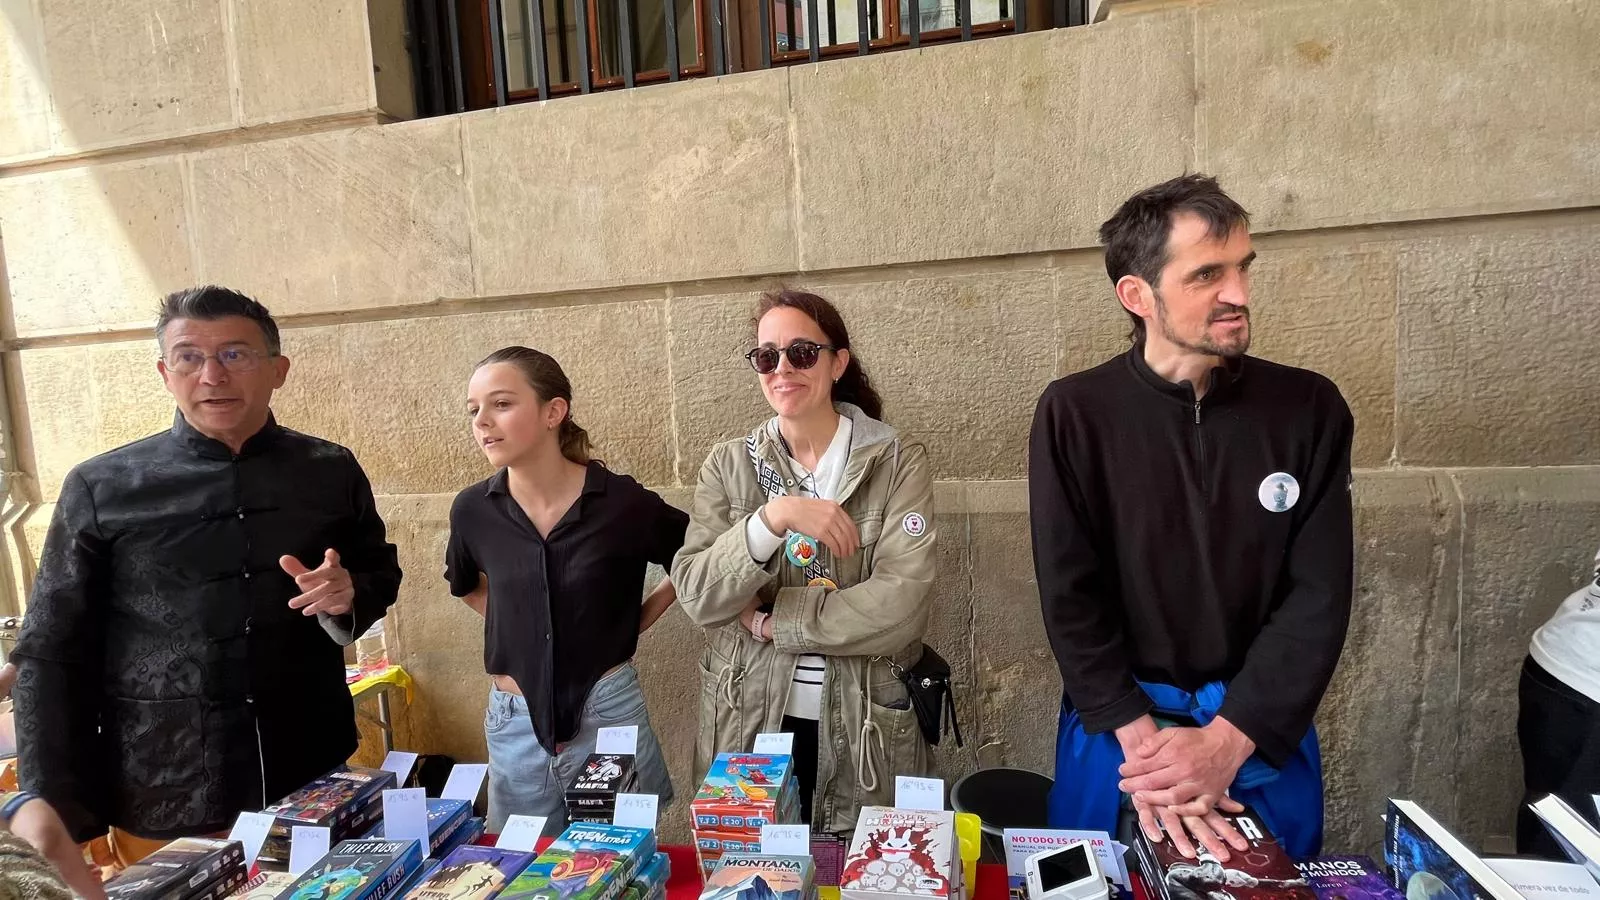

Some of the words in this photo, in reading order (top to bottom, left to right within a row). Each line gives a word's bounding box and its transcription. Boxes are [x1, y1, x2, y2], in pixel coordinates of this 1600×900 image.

[339, 843, 375, 854] THIEF
[370, 842, 403, 853] RUSH
[1070, 838, 1105, 847] GAR
[724, 857, 802, 869] MONTAÑA
[387, 863, 405, 890] RUSH
[1309, 869, 1367, 878] MUNDOS
